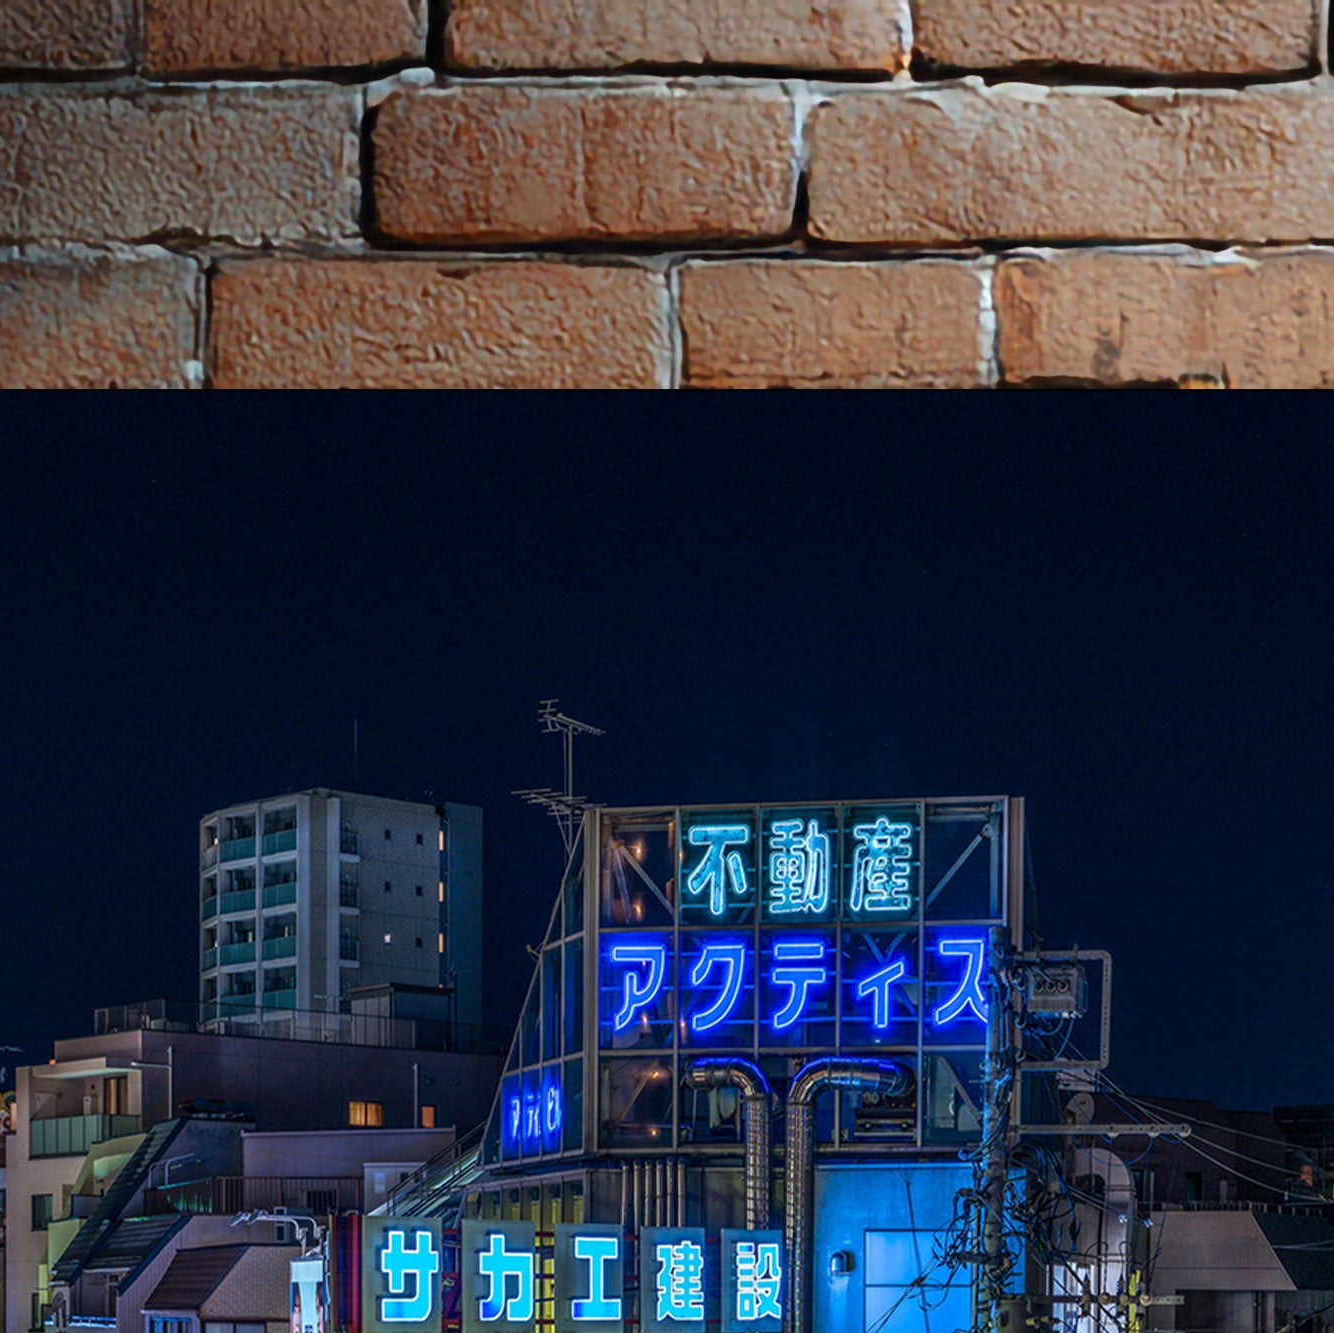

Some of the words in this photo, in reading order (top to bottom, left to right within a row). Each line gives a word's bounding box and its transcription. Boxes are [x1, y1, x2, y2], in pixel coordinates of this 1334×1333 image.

[687, 816, 913, 915] 不動産
[609, 936, 989, 1032] アクティス
[380, 1230, 782, 1322] サカエ建設
